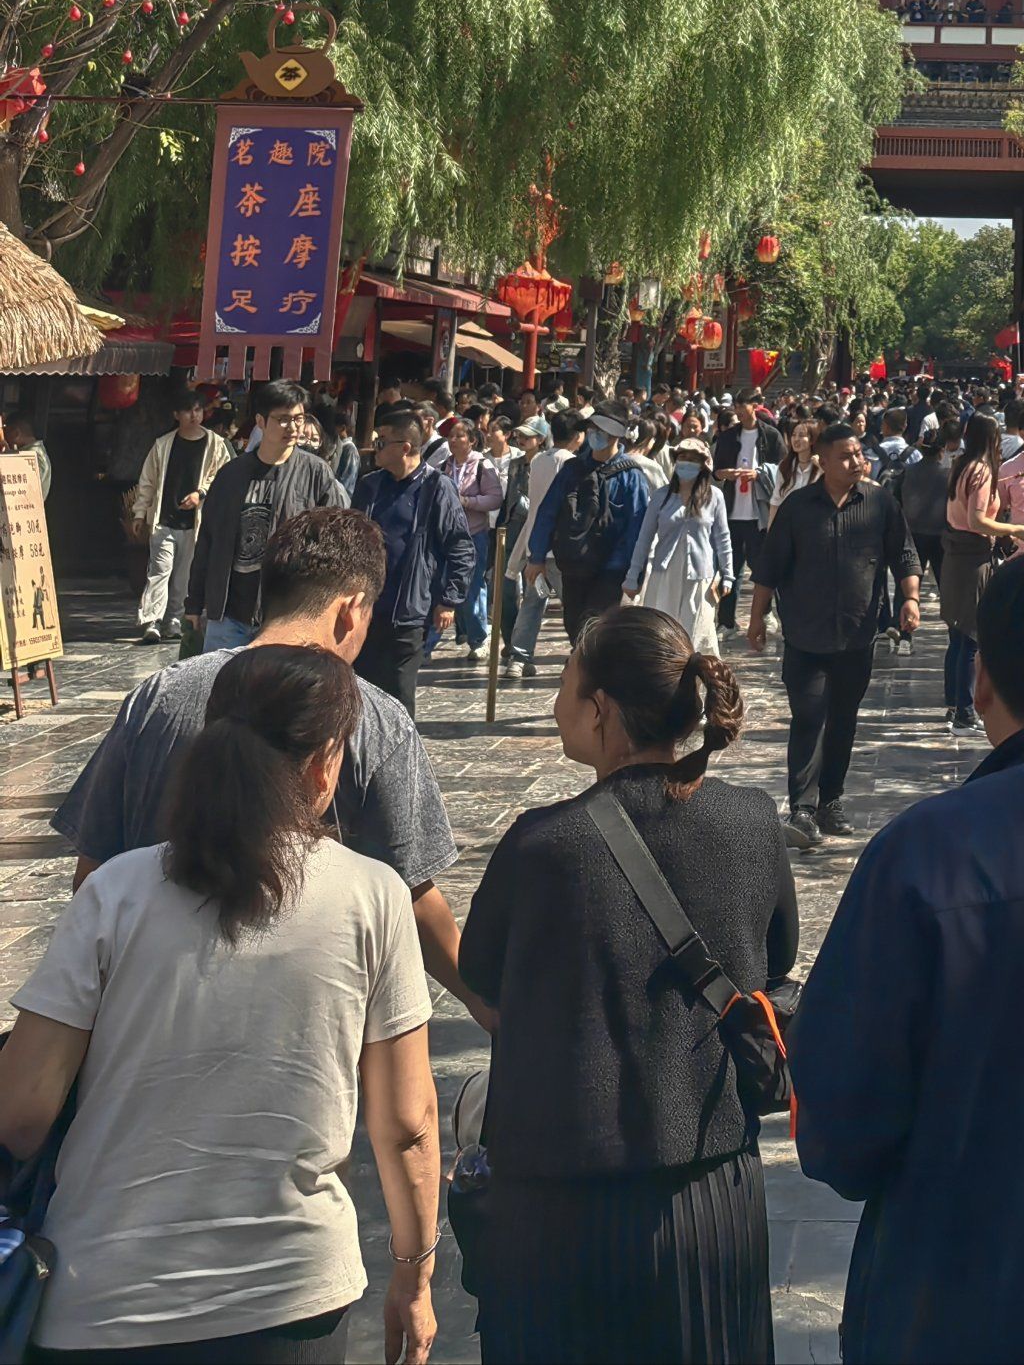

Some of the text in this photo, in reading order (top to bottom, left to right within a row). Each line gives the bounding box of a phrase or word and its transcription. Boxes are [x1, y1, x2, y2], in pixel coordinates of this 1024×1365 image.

[231, 139, 332, 166] 茗趣院
[235, 183, 322, 217] 茶座
[230, 234, 317, 269] 按摩
[223, 289, 317, 315] 足疗
